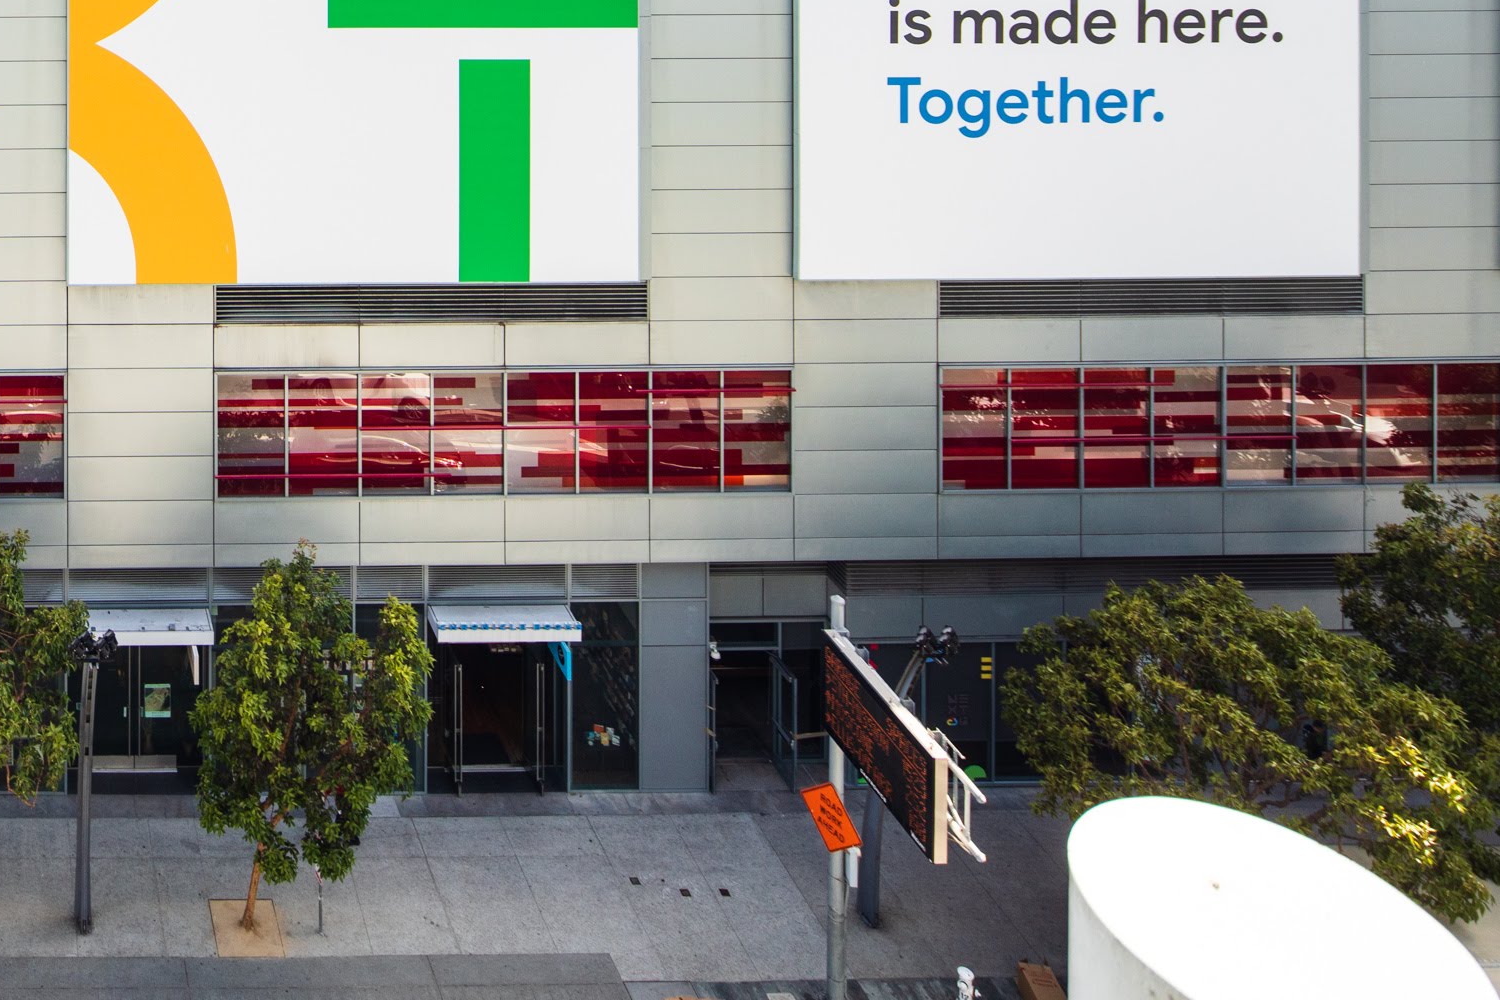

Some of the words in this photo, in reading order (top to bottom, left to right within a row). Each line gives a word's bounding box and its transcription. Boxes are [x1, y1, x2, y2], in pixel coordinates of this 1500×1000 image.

[886, 76, 1165, 139] Together.
[819, 804, 842, 828] WORK
[820, 793, 843, 817] ROAD
[817, 816, 845, 843] AHEAD
